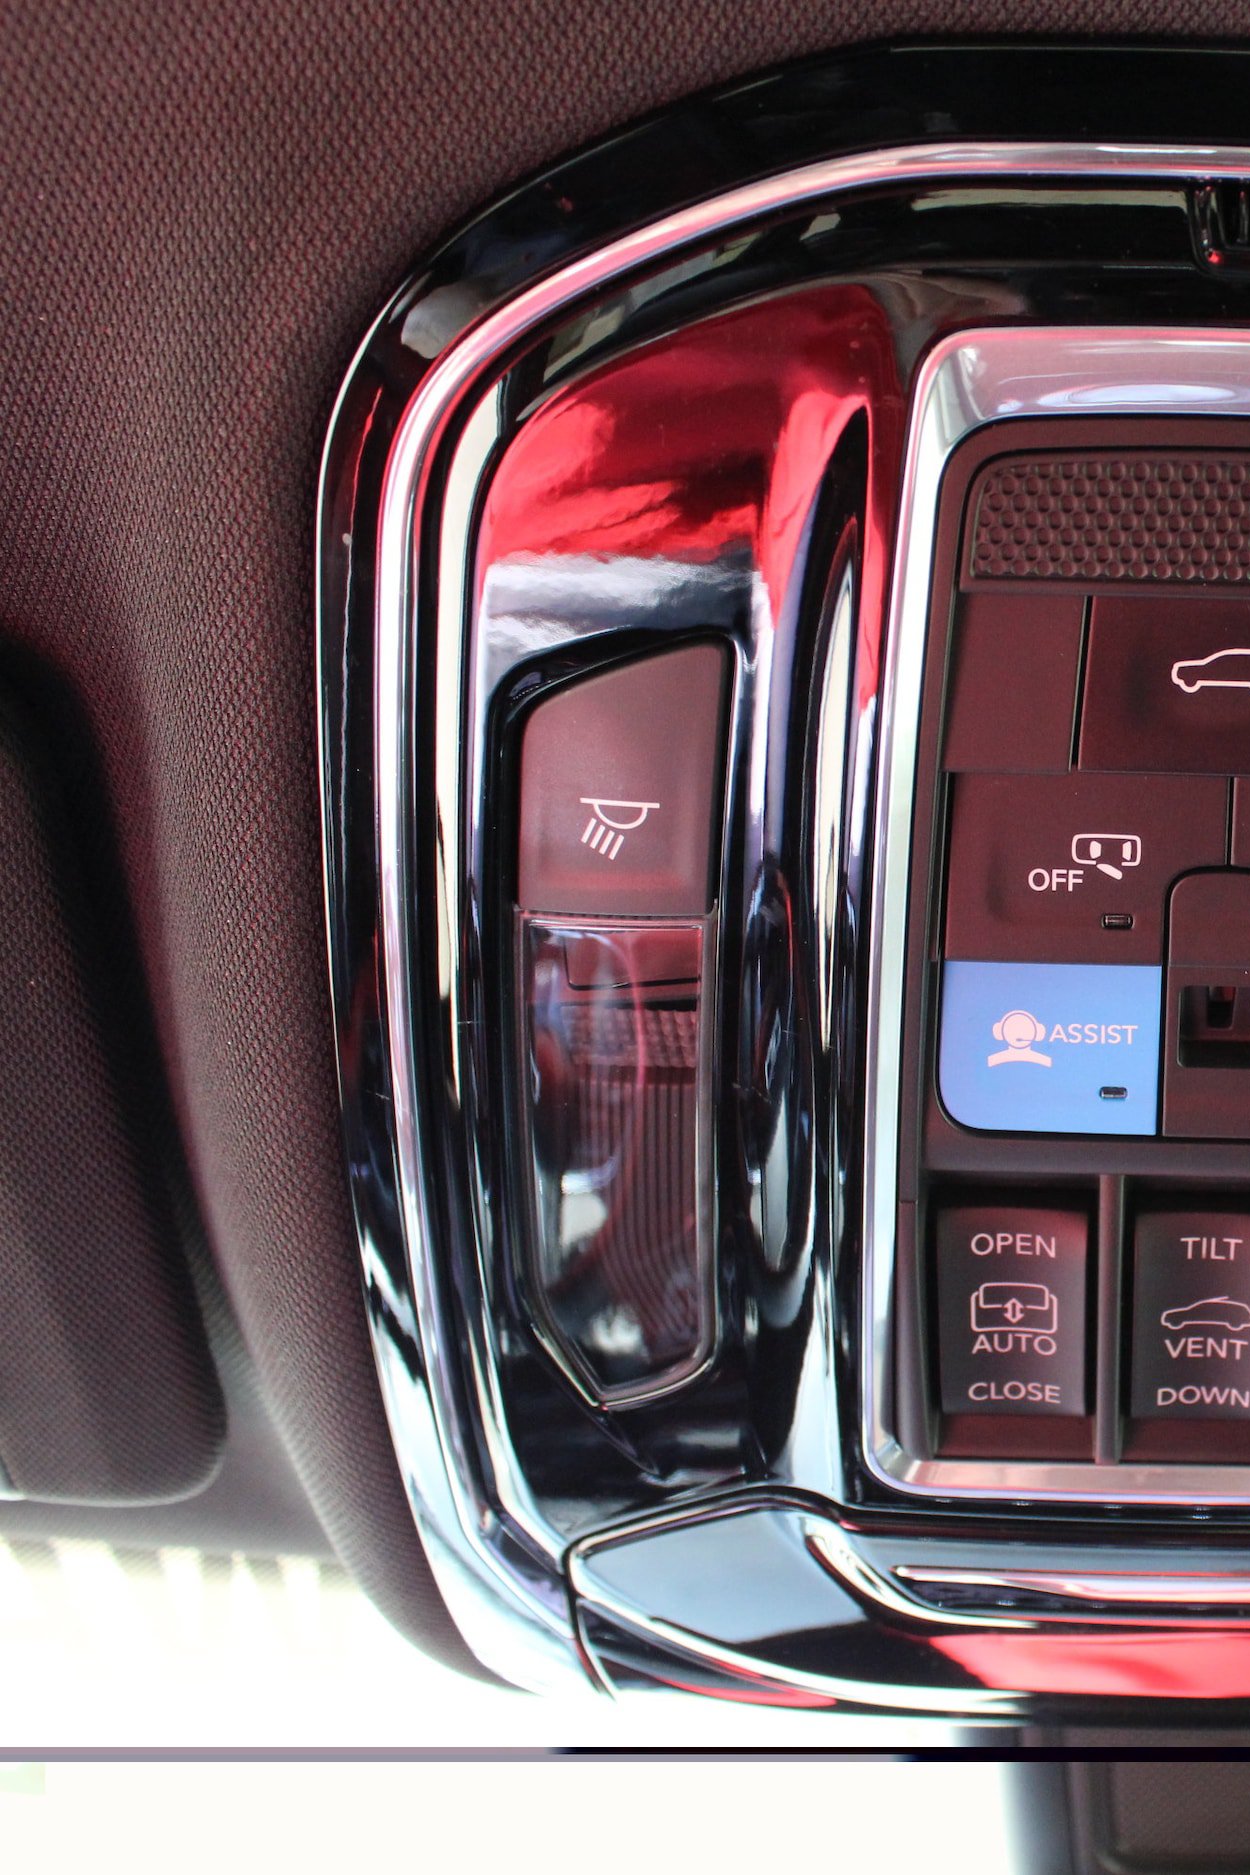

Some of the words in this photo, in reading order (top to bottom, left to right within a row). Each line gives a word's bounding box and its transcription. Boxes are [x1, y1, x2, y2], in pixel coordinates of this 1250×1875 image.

[1028, 868, 1084, 892] OFF
[1049, 1024, 1138, 1045] ASSIST
[970, 1233, 1056, 1258] OPEN
[1180, 1237, 1243, 1260] TILT
[971, 1333, 1057, 1356] AUTO
[1164, 1337, 1248, 1360] VENT
[968, 1381, 1060, 1403] CLOSE
[1156, 1386, 1250, 1408] DOWN
